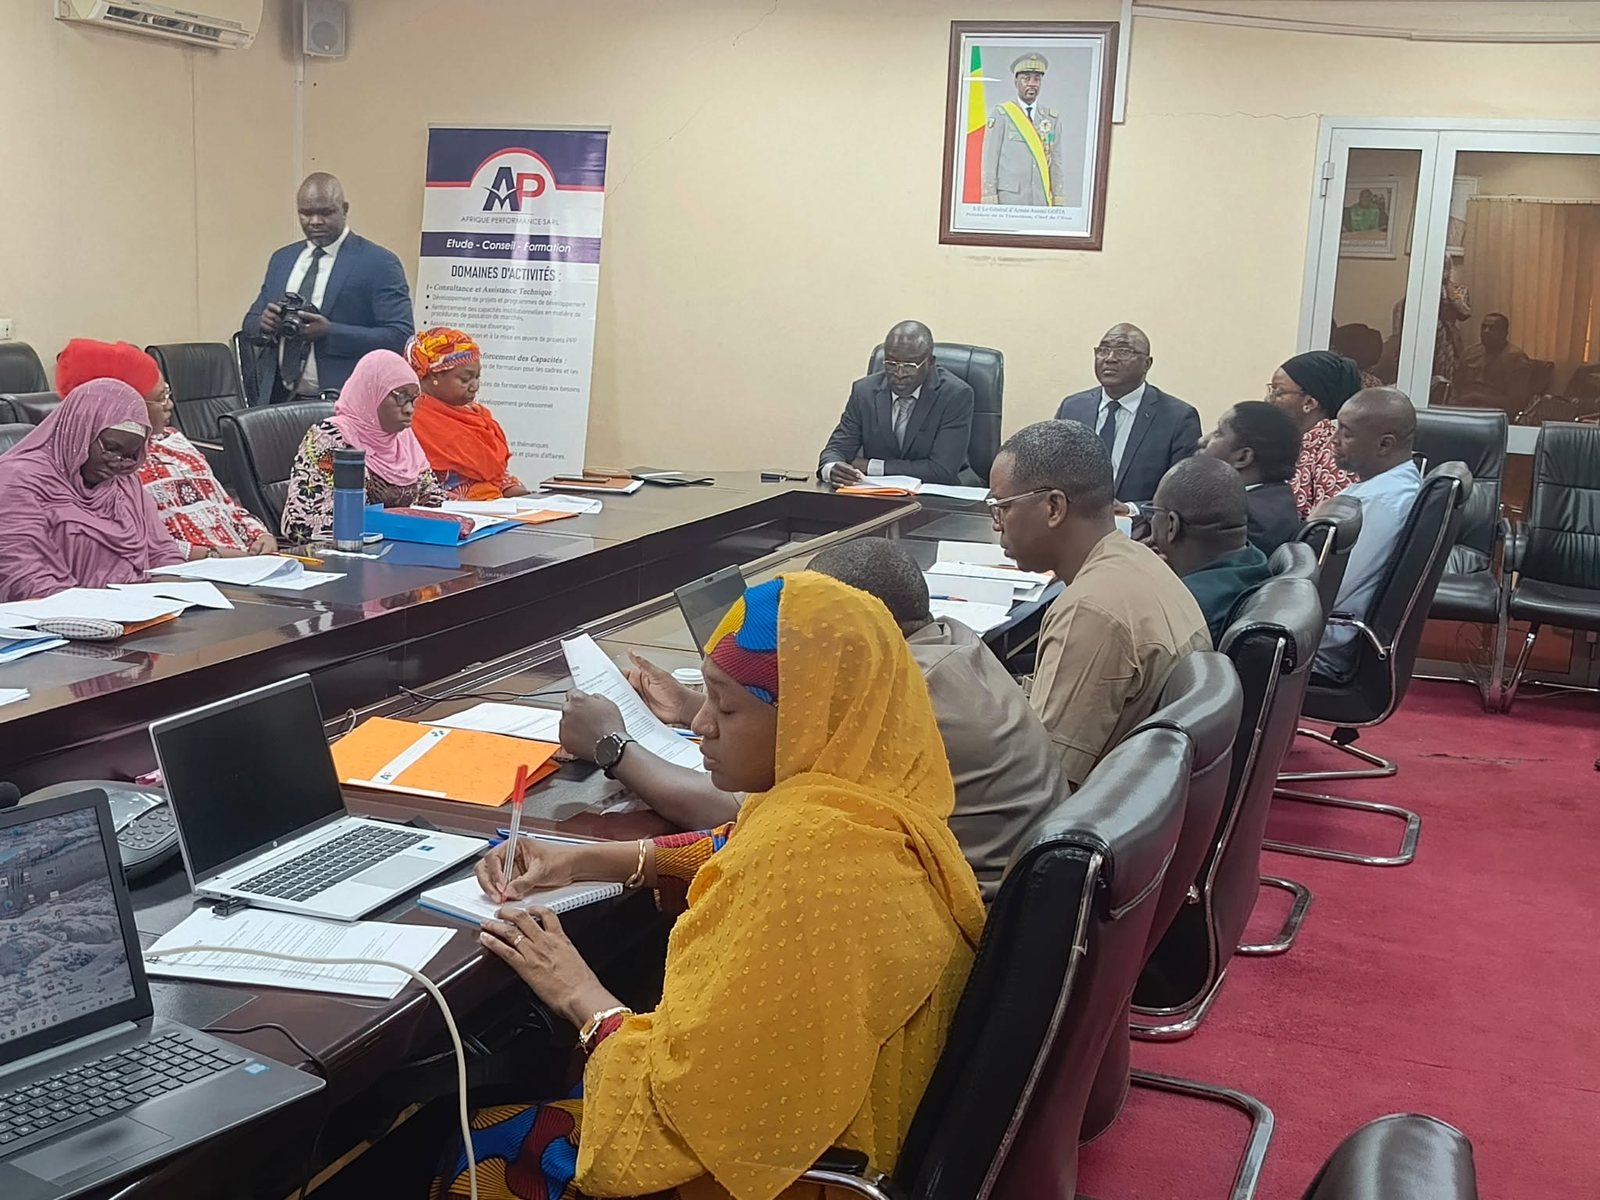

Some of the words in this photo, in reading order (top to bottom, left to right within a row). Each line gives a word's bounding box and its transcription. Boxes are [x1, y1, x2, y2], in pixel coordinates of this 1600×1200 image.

[461, 216, 491, 224] AFRIQUE
[491, 216, 542, 226] PERFORMANCE
[446, 238, 474, 249] Etude
[482, 240, 515, 252] Conseil
[524, 242, 572, 254] Formation
[452, 264, 498, 279] DOMAINES
[501, 265, 556, 281] D'ACTIVITÉS
[434, 284, 473, 292] Consultance
[482, 286, 518, 294] Assistance
[520, 288, 552, 297] Technique
[518, 354, 529, 362] des
[530, 354, 562, 364] Capacités
